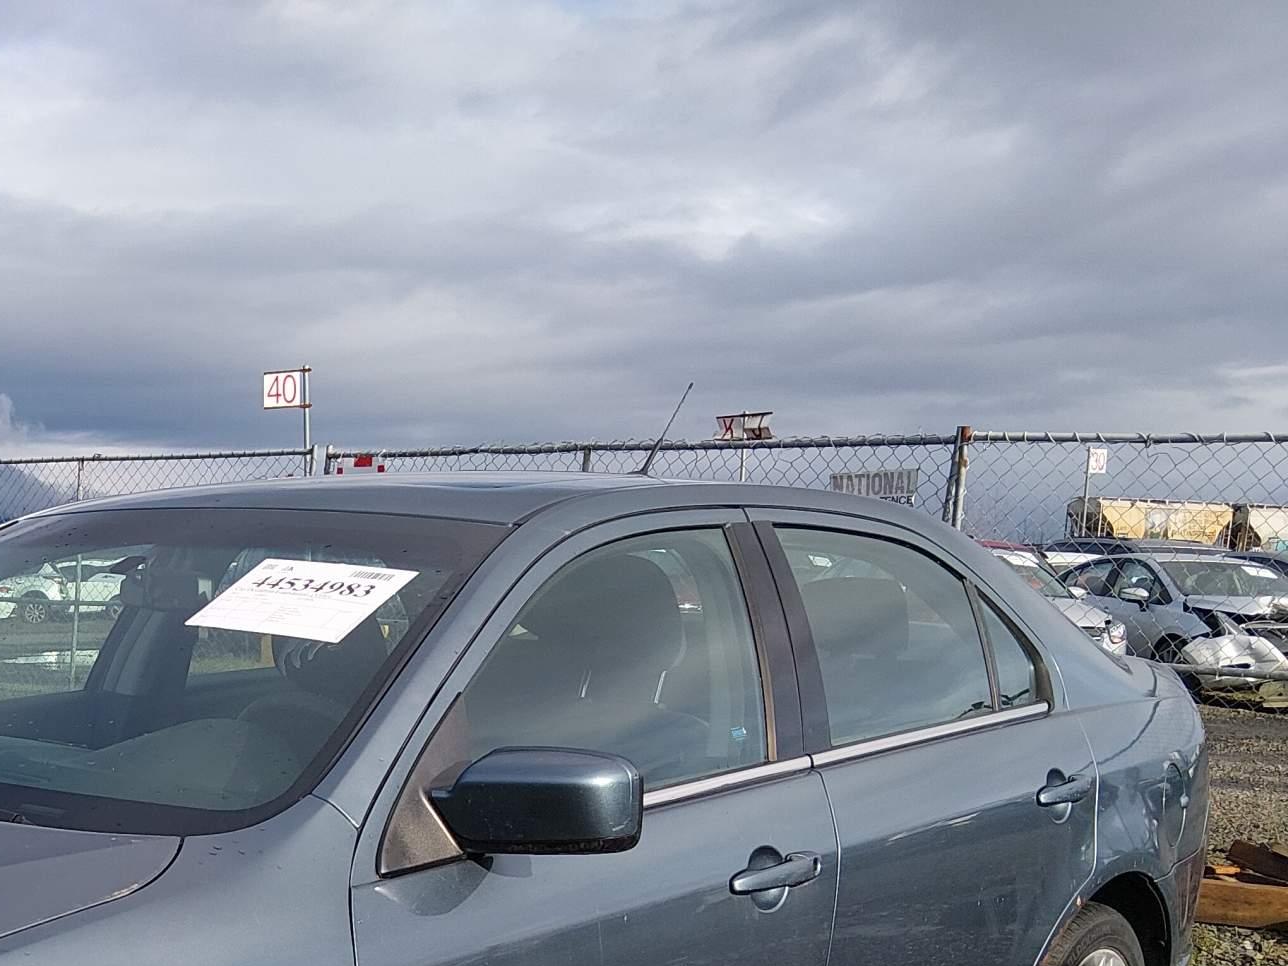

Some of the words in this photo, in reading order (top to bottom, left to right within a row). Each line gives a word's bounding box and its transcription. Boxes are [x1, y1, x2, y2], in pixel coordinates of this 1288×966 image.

[266, 374, 297, 405] 40
[832, 471, 914, 496] NATIONAL
[251, 575, 376, 598] 44534983
